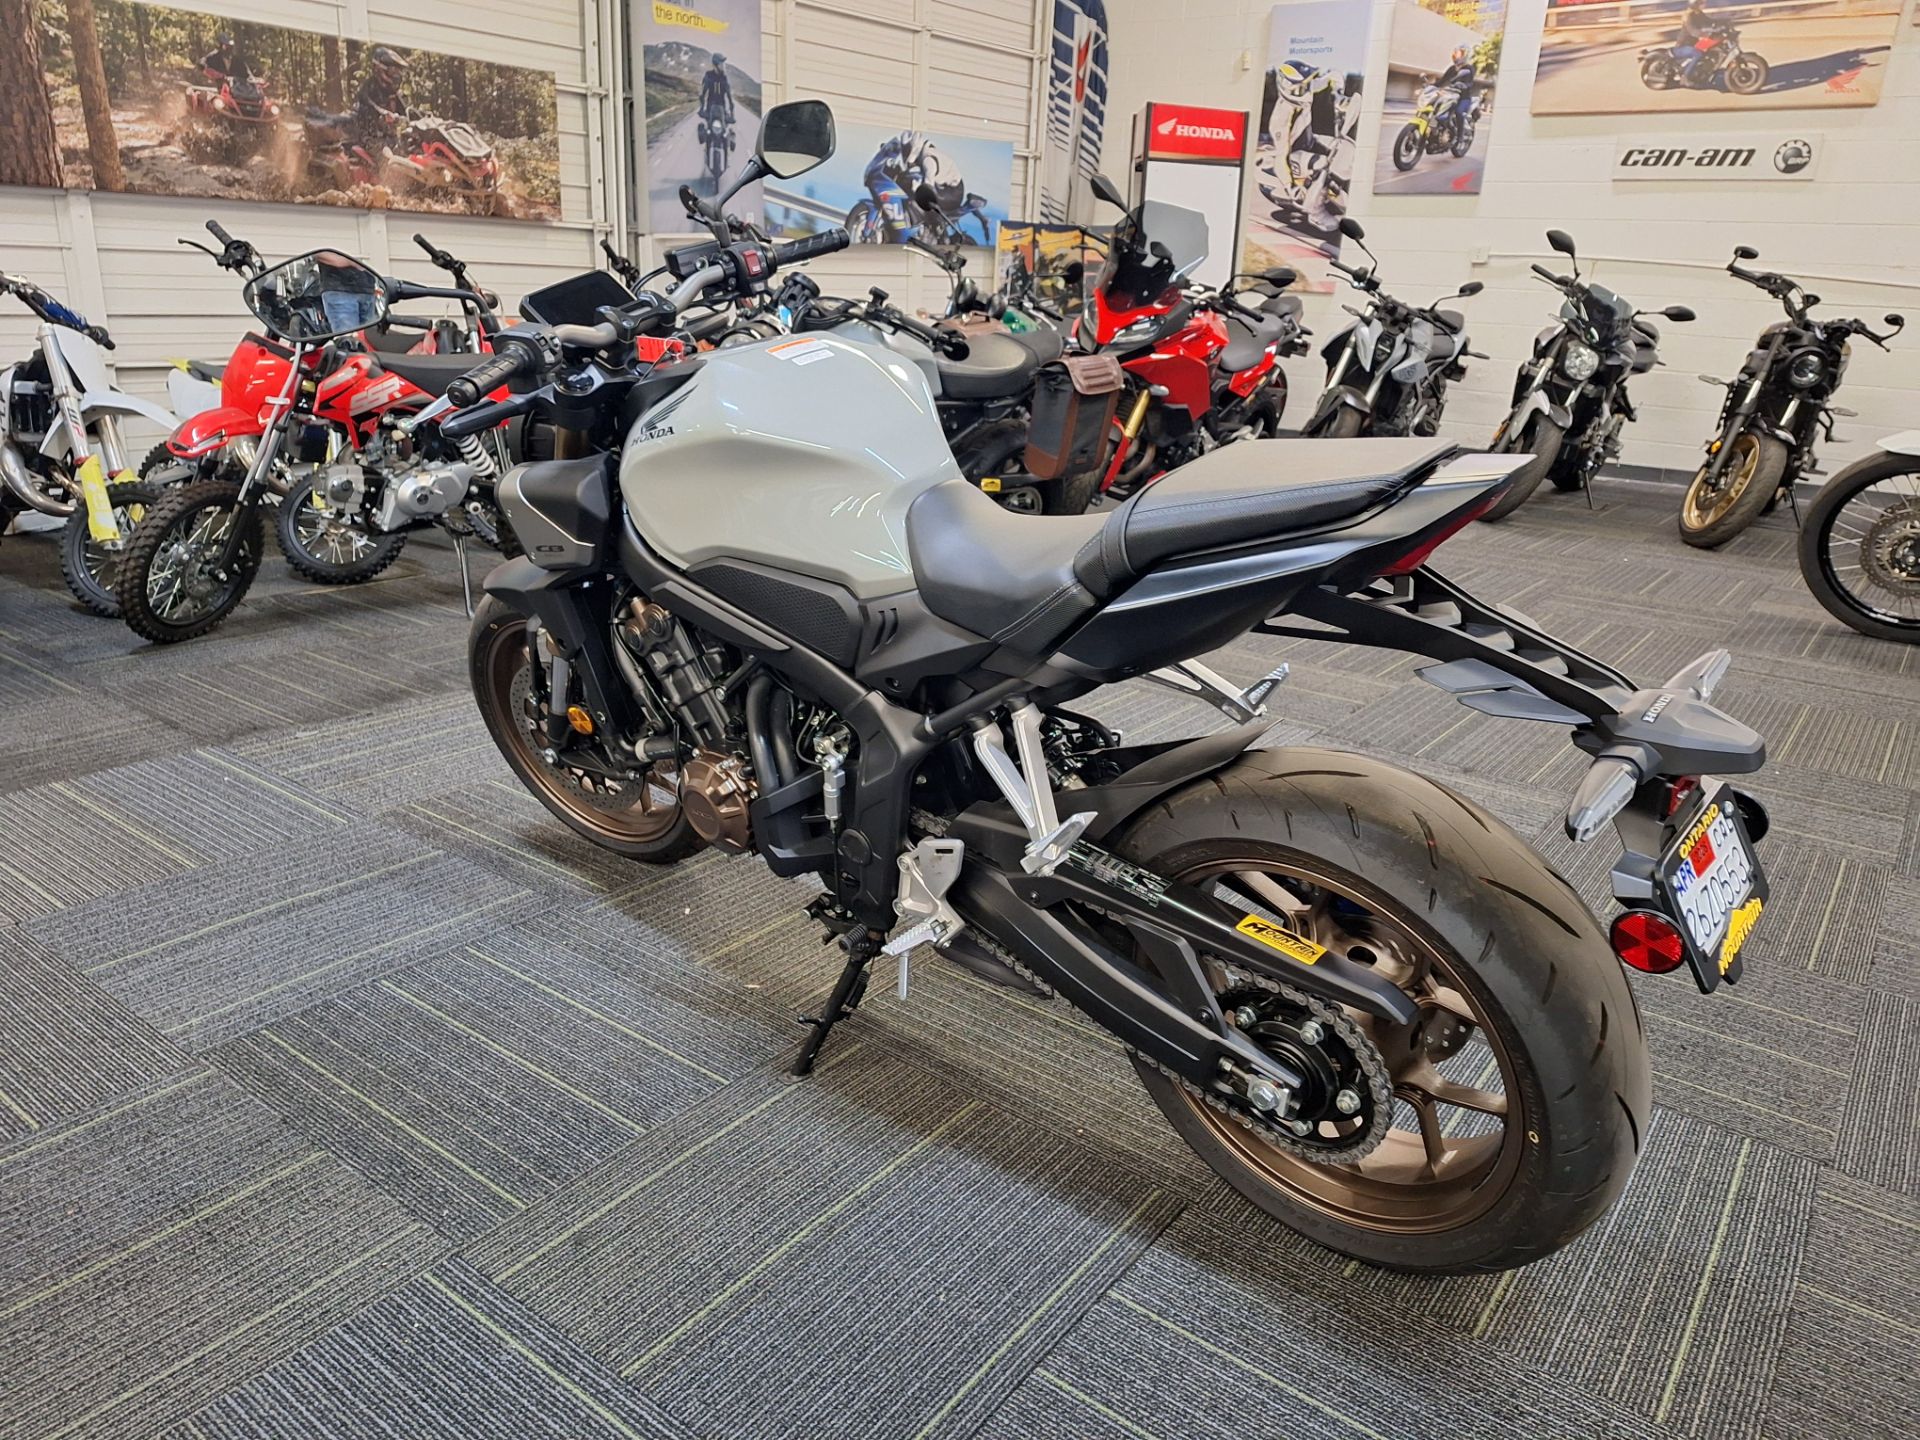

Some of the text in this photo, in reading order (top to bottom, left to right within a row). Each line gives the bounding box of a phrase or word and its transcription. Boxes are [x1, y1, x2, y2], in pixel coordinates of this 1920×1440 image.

[656, 5, 672, 20] the
[1176, 124, 1235, 141] HONDA
[1620, 148, 1756, 167] can-am
[349, 376, 402, 417] SSR
[631, 426, 675, 447] HONDA
[1679, 803, 1719, 859] ONTARIO
[1243, 922, 1319, 956] MOUNTAIN
